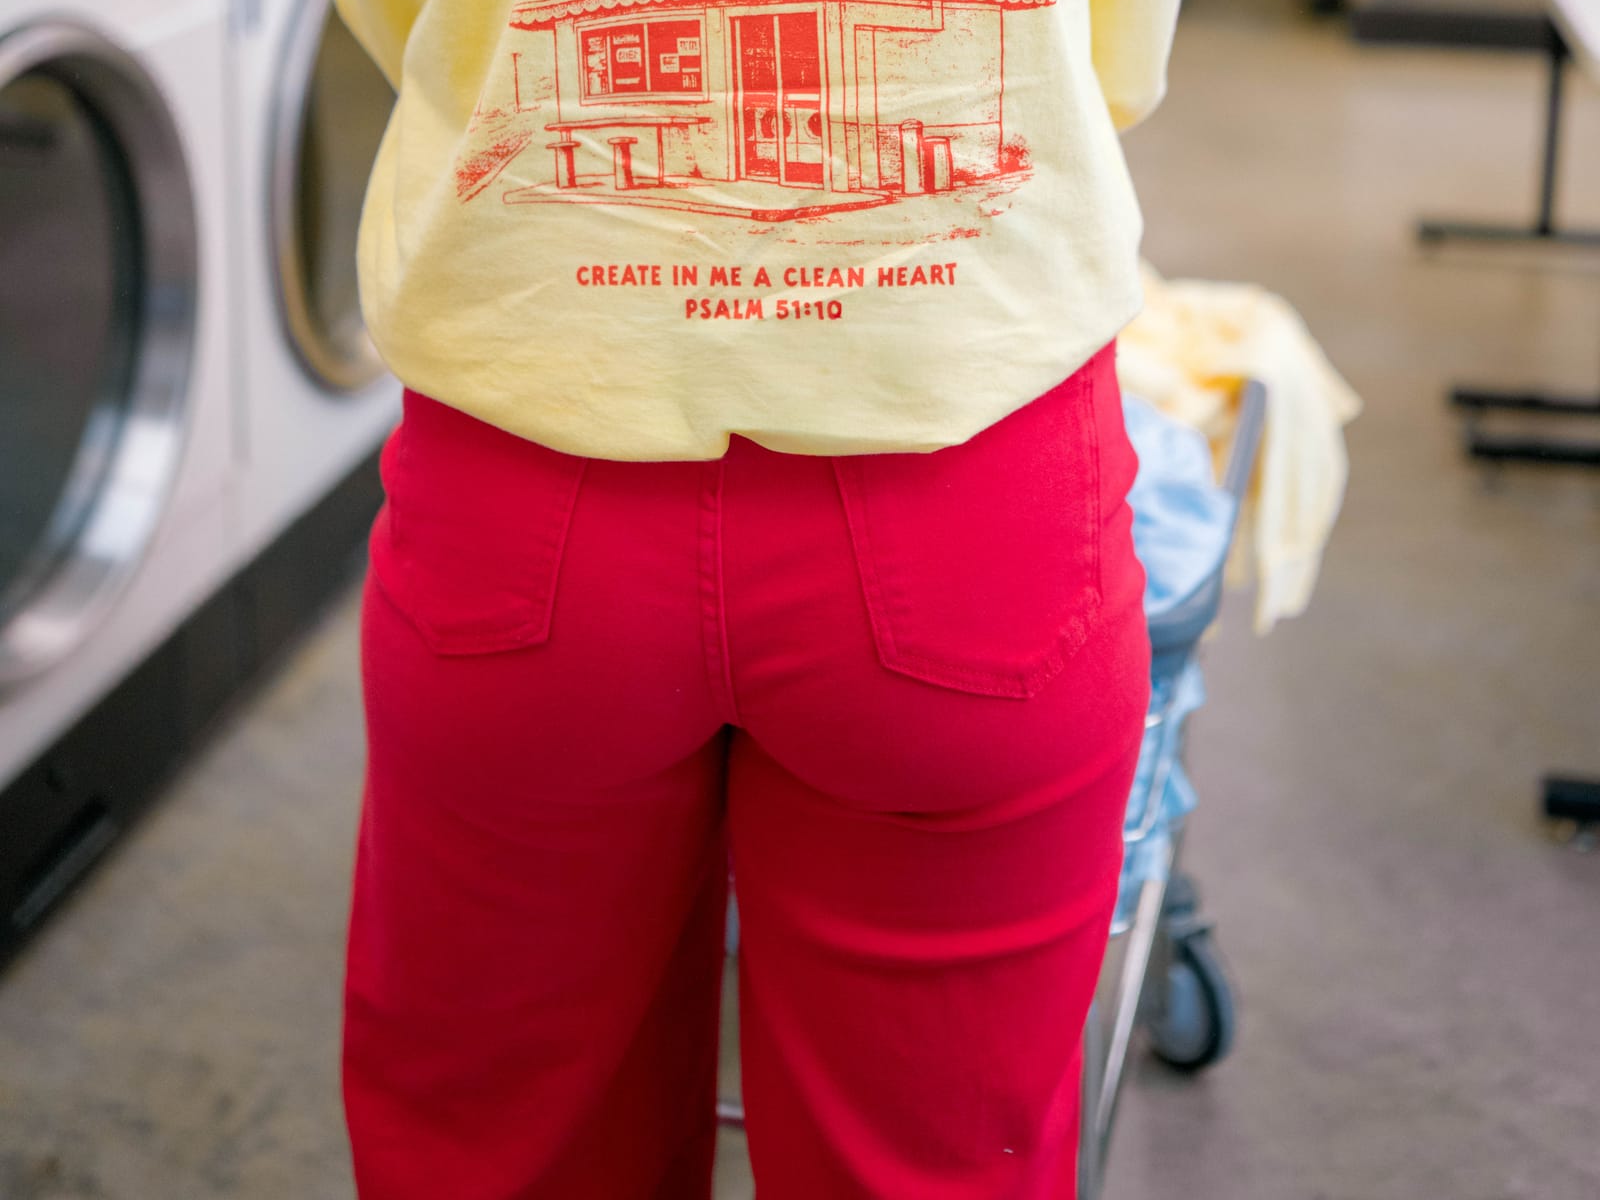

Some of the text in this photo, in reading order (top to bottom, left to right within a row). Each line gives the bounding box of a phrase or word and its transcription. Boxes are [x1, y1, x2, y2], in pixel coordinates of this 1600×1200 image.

[576, 262, 957, 288] CREATE IN ME A CLEAN HEART
[685, 298, 842, 320] PSALM 51:10
